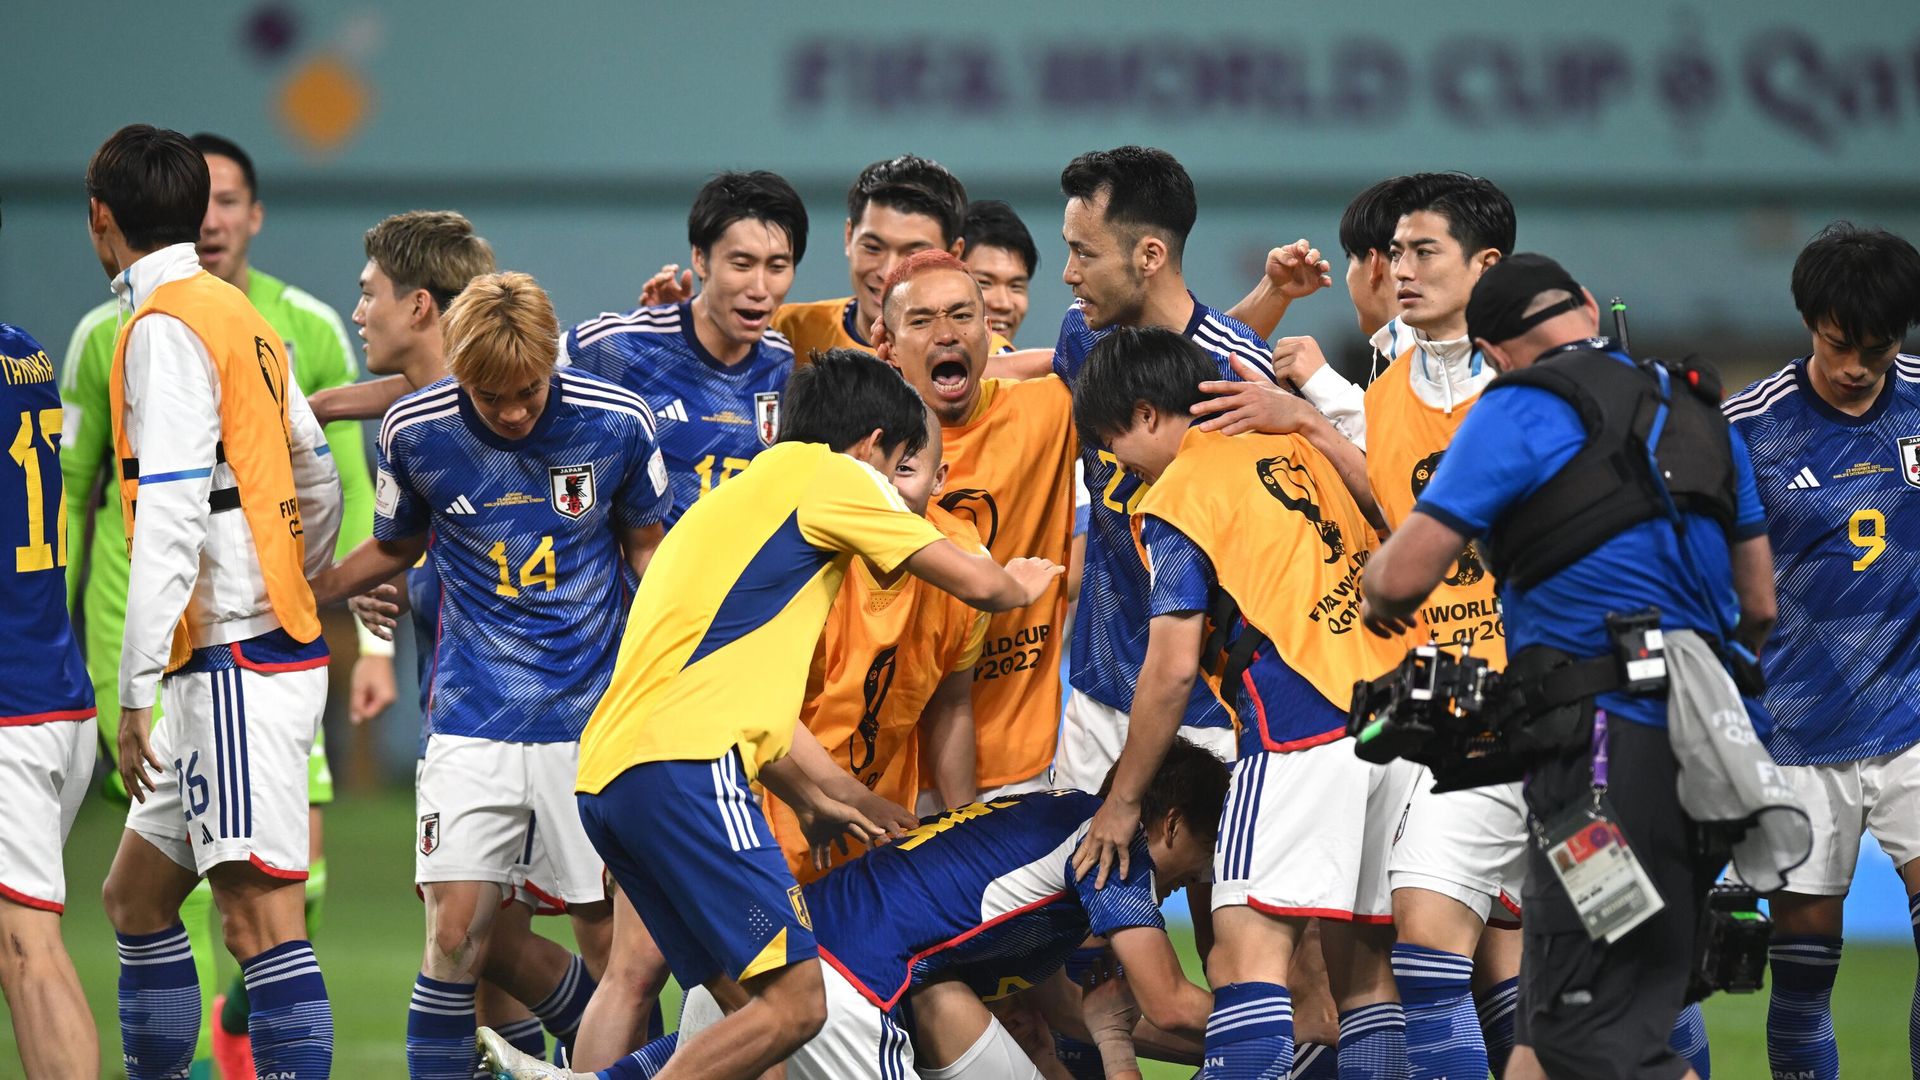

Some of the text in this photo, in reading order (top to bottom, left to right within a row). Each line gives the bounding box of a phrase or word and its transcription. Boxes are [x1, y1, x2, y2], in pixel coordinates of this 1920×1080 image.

[786, 38, 1006, 118] FIFA
[1036, 38, 1402, 122] WORLD
[1430, 38, 1628, 122] CUP
[0, 350, 55, 386] TANAKA
[487, 535, 557, 598] 14
[1848, 508, 1886, 572] 9
[1015, 624, 1050, 647] CUP
